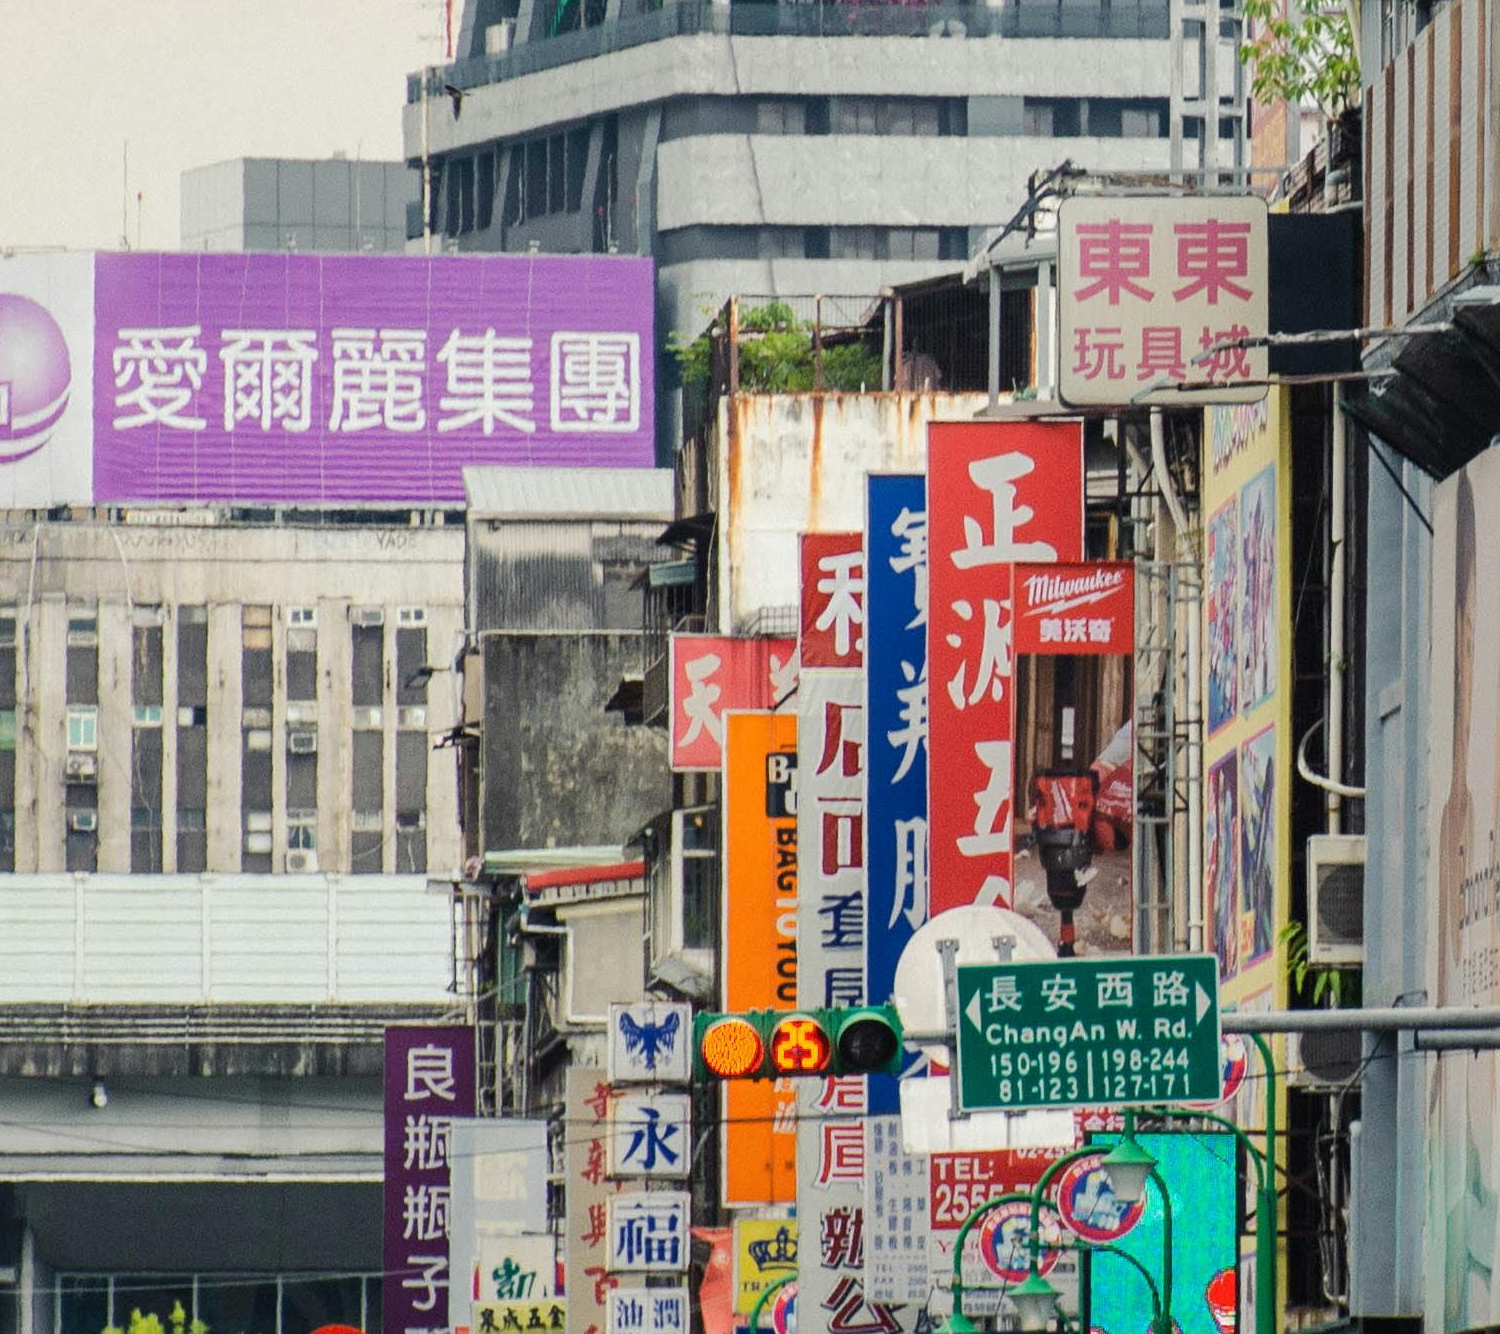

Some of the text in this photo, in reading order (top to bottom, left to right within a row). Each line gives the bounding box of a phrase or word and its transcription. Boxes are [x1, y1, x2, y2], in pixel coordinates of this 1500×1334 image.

[1074, 217, 1253, 307] 東東
[1071, 324, 1253, 381] 玩具城
[111, 326, 642, 435] 愛爾麗集團
[1023, 569, 1126, 607] Milwaukee
[1039, 616, 1113, 644] 美沃奇
[985, 972, 1191, 1013] 長安西路
[985, 1018, 1194, 1051] ChangAn W. Rd.
[990, 1049, 1190, 1077] 150-196 198-244
[999, 1075, 1192, 1103] 81-123 127-171
[933, 1158, 995, 1182] TEL:
